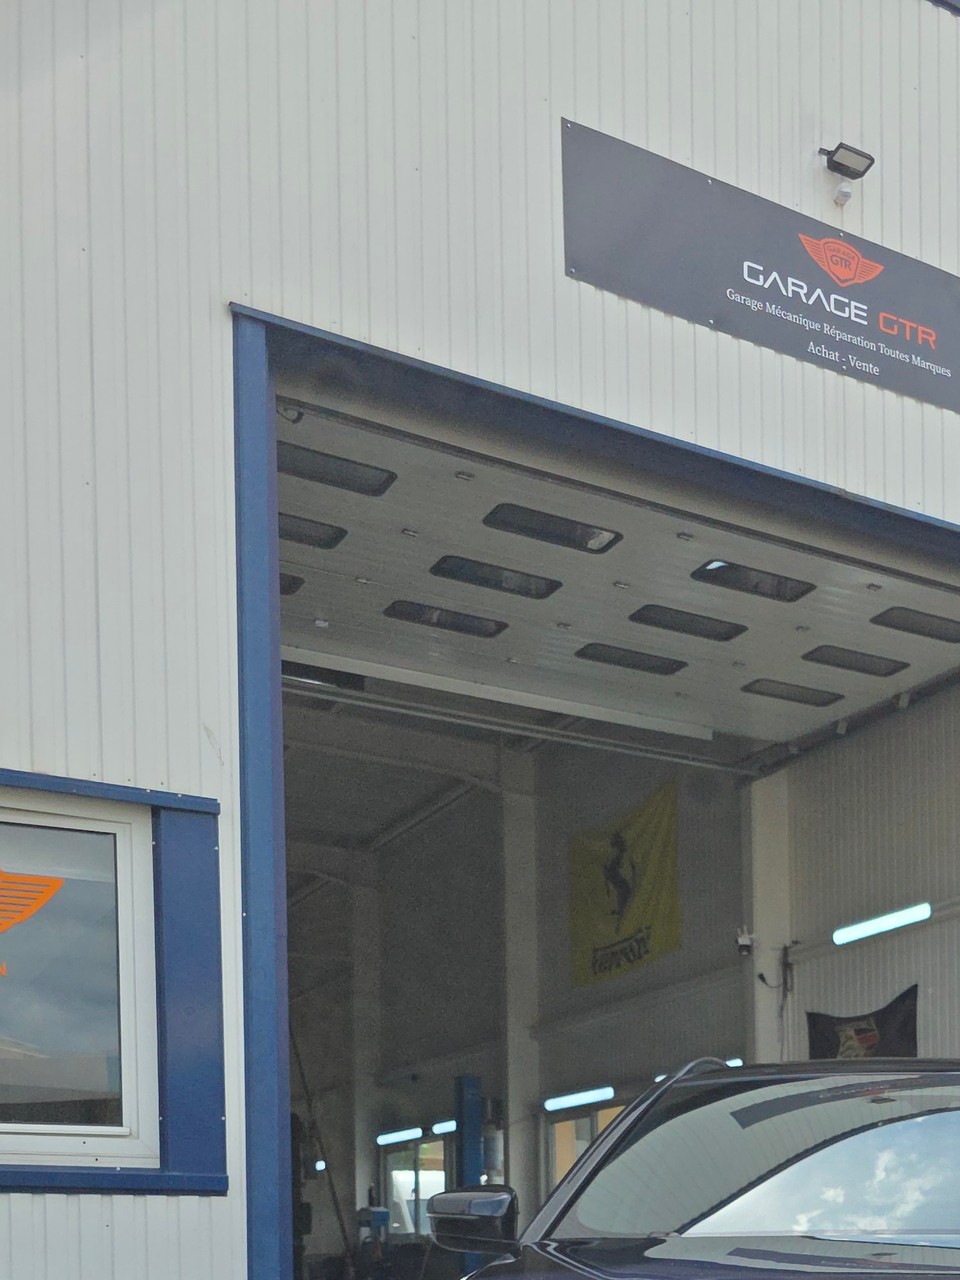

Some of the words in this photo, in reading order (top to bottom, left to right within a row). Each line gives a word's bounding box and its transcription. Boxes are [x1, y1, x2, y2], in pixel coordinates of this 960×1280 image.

[726, 288, 764, 312] Garage
[765, 302, 821, 331] Mécanique
[823, 322, 877, 352] Réparation
[878, 342, 910, 363] Toutes
[911, 354, 952, 378] Marques
[743, 261, 868, 326] GARAGE
[879, 312, 937, 350] GTR
[807, 341, 840, 363] Achat
[848, 354, 880, 376] Vente
